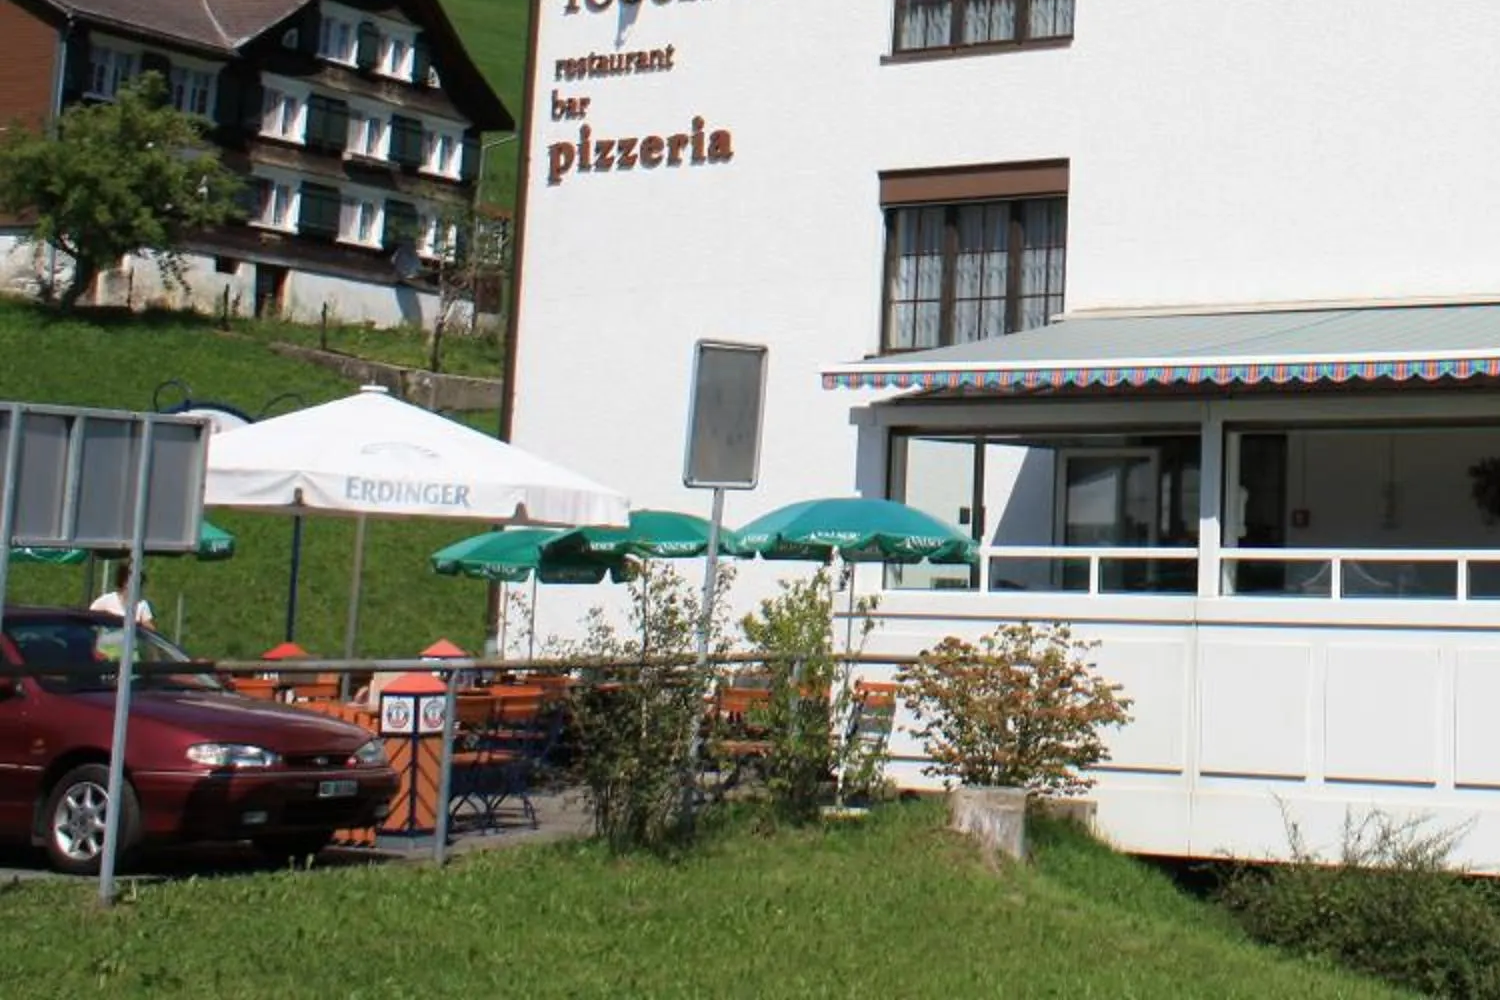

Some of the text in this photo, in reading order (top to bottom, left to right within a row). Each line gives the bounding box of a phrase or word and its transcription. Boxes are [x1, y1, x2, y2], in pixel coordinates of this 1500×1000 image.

[555, 43, 675, 82] restaurant
[551, 89, 591, 122] bar
[547, 115, 734, 187] pizzeria
[345, 475, 472, 509] ERDINGER
